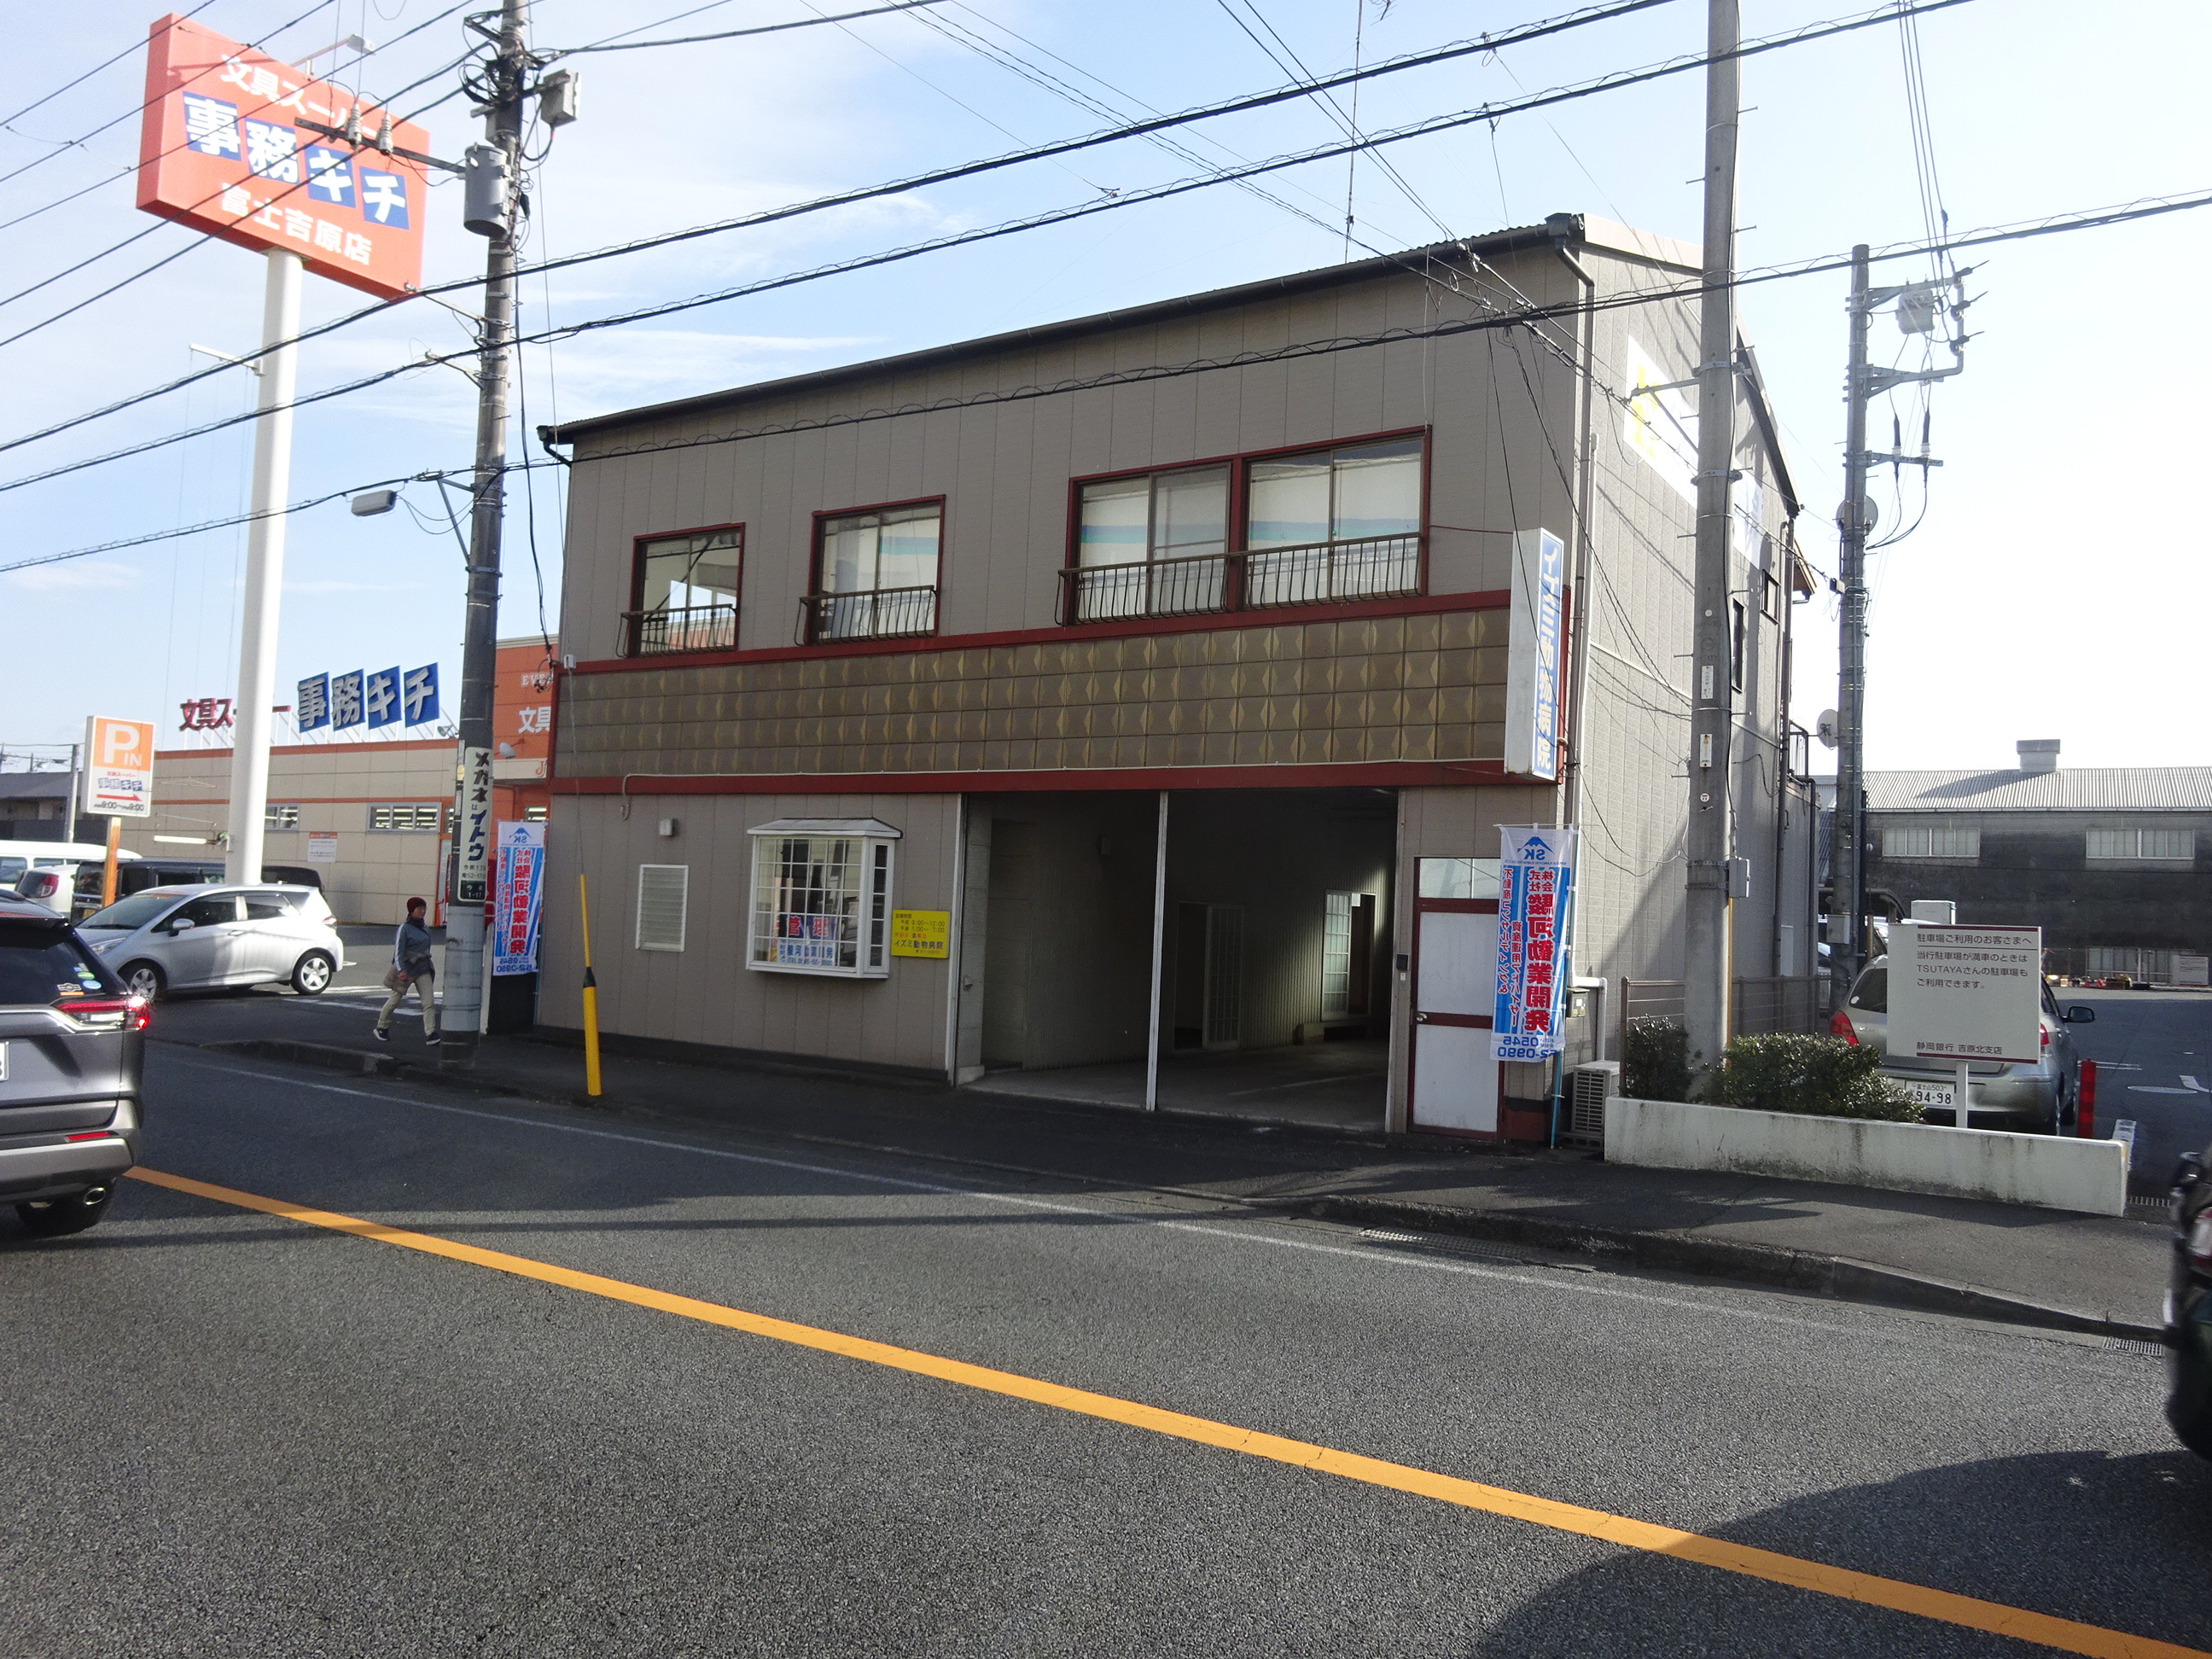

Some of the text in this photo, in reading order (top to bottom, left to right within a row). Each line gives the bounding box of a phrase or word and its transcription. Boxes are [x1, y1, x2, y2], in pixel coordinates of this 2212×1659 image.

[183, 96, 407, 224] 事務キチ
[221, 182, 372, 266] 富士吉原店
[1536, 546, 1559, 770] イズミ動物病院
[298, 667, 435, 729] 事務キチ
[179, 697, 292, 731] 文具スー
[518, 706, 551, 734] 文具
[103, 722, 140, 764] P
[124, 752, 143, 766] IN
[468, 750, 490, 861] メガネはイトウ
[788, 916, 829, 937] 管理
[894, 939, 944, 950] イズミ動物病院
[1917, 933, 2032, 945] 駐車場ご利用のお客さまへ
[1917, 951, 2028, 963] 当行駐車場が満車のときは
[1917, 964, 2029, 977] TSUTAYAさんの駐車場も
[1917, 978, 1985, 989] ご利用できます。
[1916, 1041, 2002, 1055] 静岡銀行 吉原北支店
[1916, 1091, 1952, 1104] 94-98
